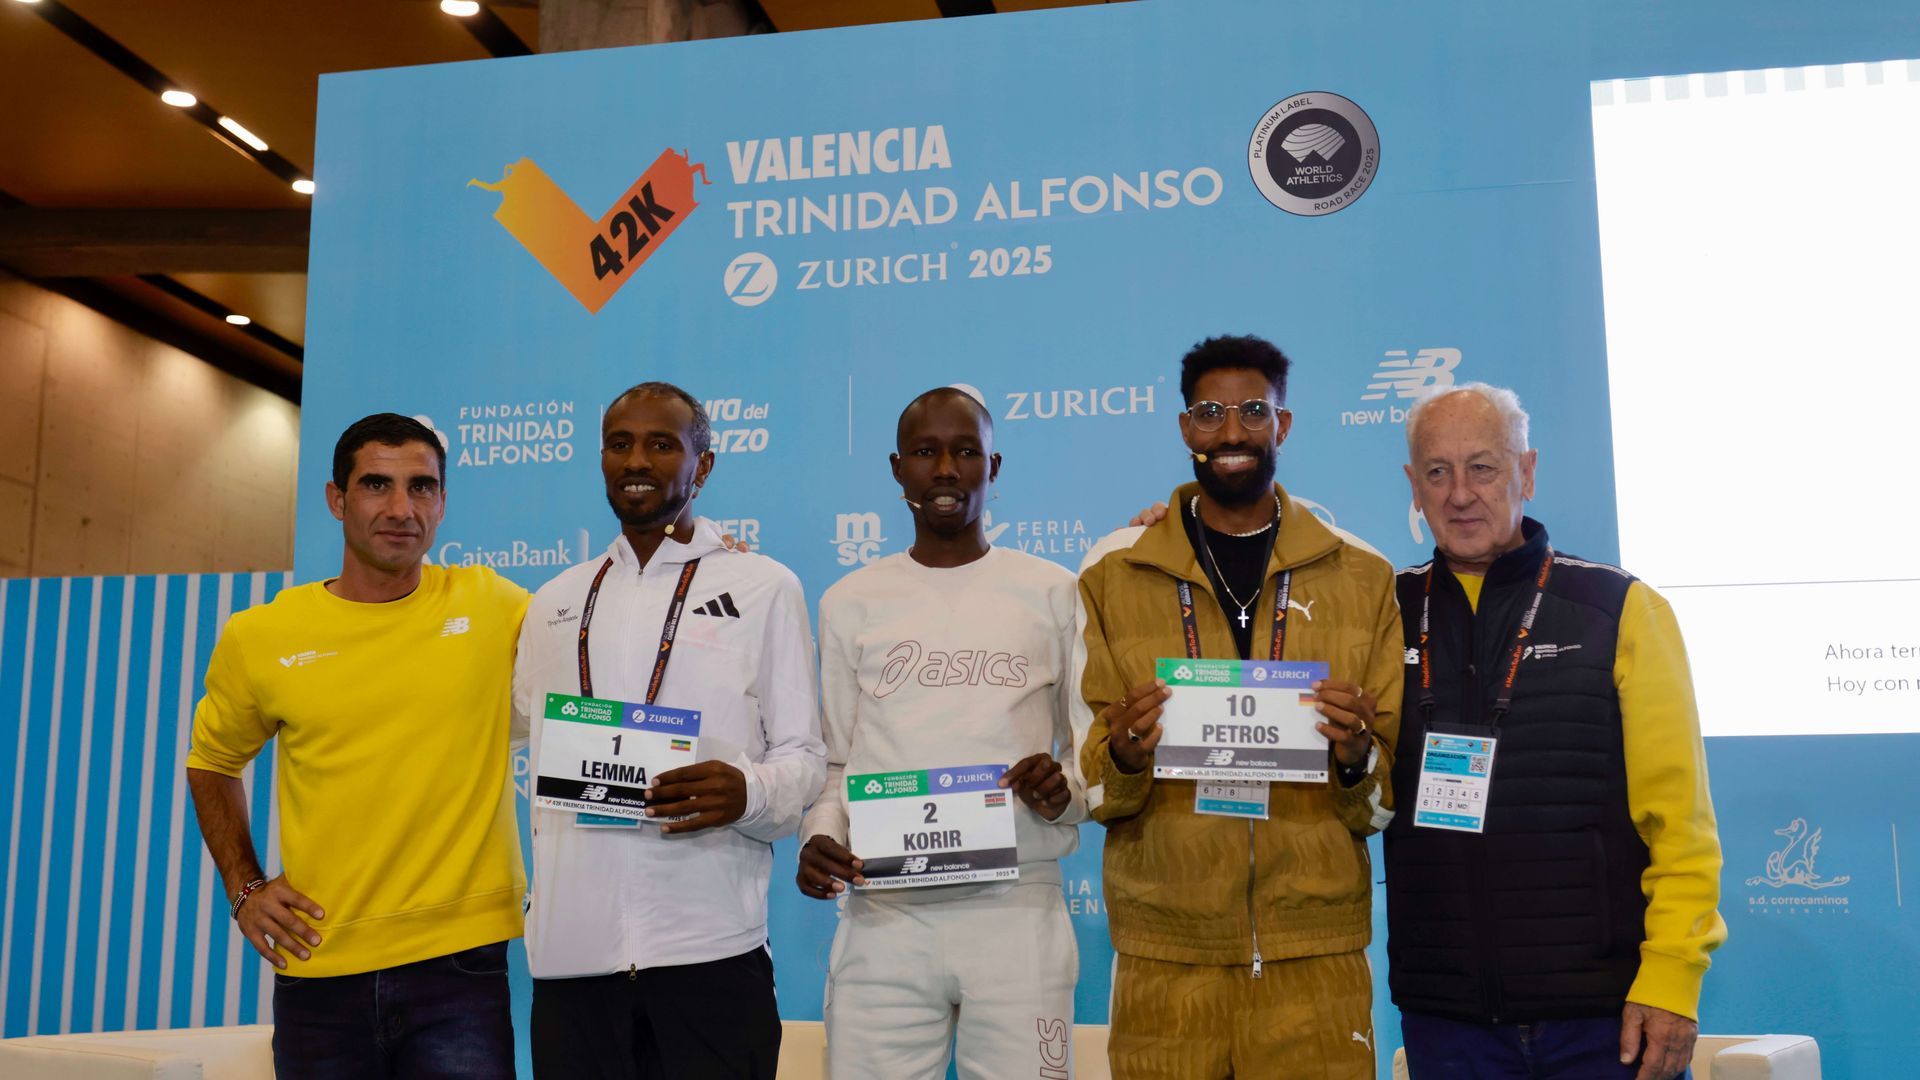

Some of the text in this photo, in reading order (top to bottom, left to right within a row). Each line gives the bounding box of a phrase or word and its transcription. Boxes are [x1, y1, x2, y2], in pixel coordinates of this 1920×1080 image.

[1253, 97, 1312, 159] PLATINUM LABEL
[726, 125, 952, 185] VALENCIA
[1295, 165, 1334, 176] WORLD
[1314, 147, 1375, 211] ROAD RACE 2025
[1286, 173, 1343, 186] ATHLETICS
[726, 167, 1224, 239] TRINIDAD ALFONSO
[588, 181, 675, 281] 42K
[796, 252, 948, 290] ZURICH
[968, 245, 1052, 279] 2025
[460, 400, 573, 420] FUNDACIÓN
[743, 403, 769, 420] del
[1004, 385, 1156, 421] ZURICH
[1341, 409, 1385, 426] new
[458, 419, 574, 445] TRINIDAD
[457, 442, 573, 467] ALFONSO
[1017, 519, 1086, 537] FERIA
[440, 539, 572, 568] CaixaBank
[1825, 643, 1920, 660] Ahora ter
[1195, 669, 1230, 677] TRINIDAD
[1271, 670, 1310, 680] ZURICH
[1828, 675, 1867, 696] Hoy
[1873, 679, 1909, 691] con
[580, 706, 613, 716] TRINIDAD
[1226, 694, 1256, 718] 10
[579, 713, 612, 722] ALFONSO
[648, 714, 684, 726] ZURICH
[1202, 724, 1279, 745] PETROS
[611, 734, 622, 756] 1
[581, 760, 647, 785] LEMMA
[956, 773, 993, 784] ZURICH
[1211, 769, 1243, 778] TRINIDAD
[1244, 770, 1276, 779] ALFONSO
[884, 780, 918, 789] TRINIDAD
[885, 786, 918, 795] ALFONSO
[1203, 786, 1235, 796] 6 7 8
[1437, 787, 1442, 795] 2
[1449, 789, 1454, 797] 3
[1461, 790, 1467, 798] 4
[1474, 791, 1479, 799] 5
[562, 801, 585, 810] VALENCIA
[586, 804, 614, 814] TRINIDAD
[614, 807, 644, 817] ALFONSO
[608, 796, 645, 807] new balance
[923, 802, 938, 824] 2
[903, 829, 962, 851] KORIR
[943, 863, 970, 871] balance
[883, 878, 907, 886] VALENCIA
[908, 875, 938, 885] TRINIDAD
[939, 873, 970, 882] ALFONSO
[1771, 895, 1849, 905] correcaminos
